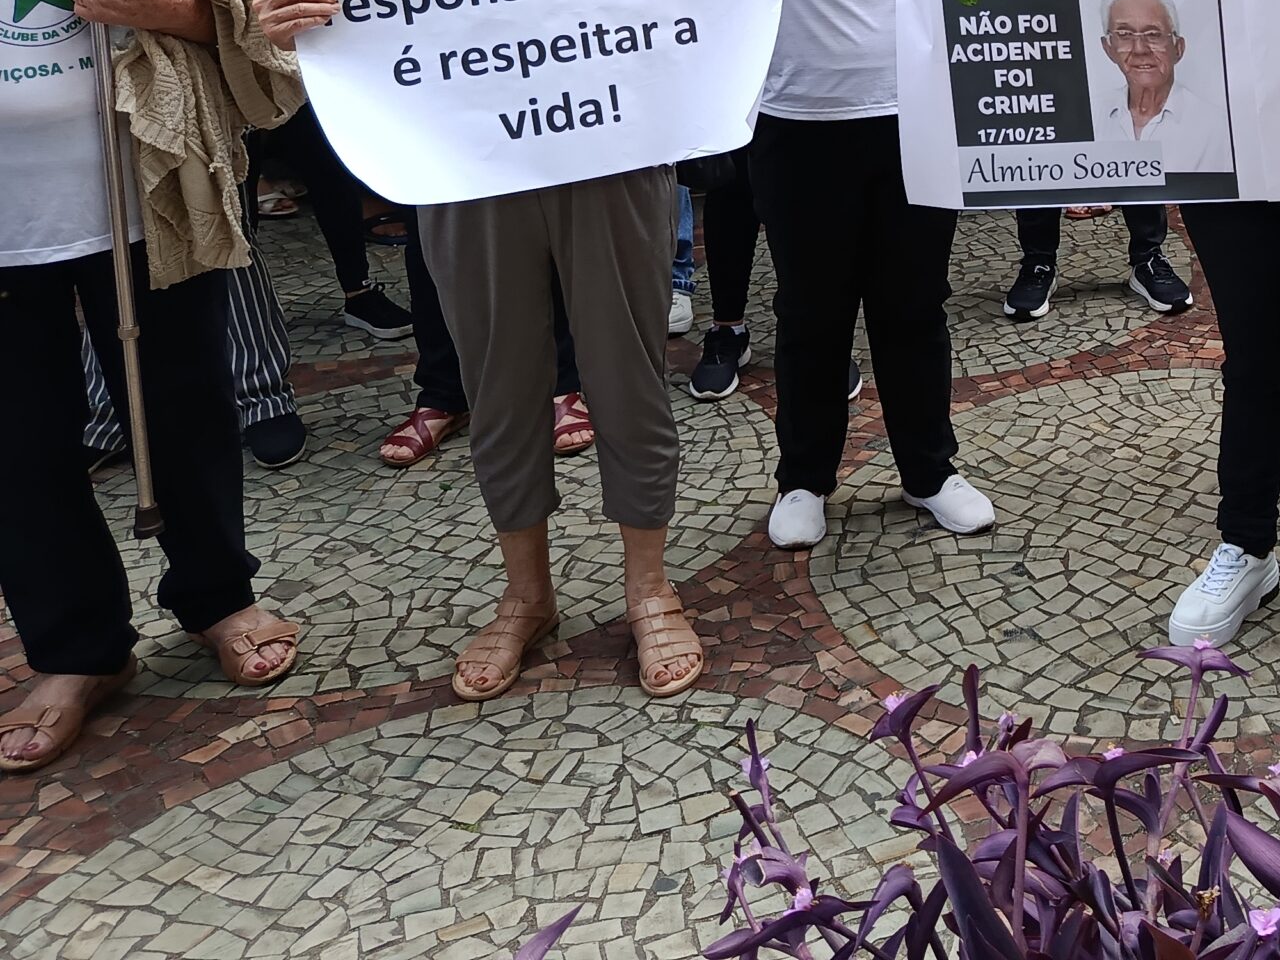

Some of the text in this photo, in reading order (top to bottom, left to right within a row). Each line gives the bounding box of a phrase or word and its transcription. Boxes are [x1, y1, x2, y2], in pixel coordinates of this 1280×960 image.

[42, 30, 60, 41] DA
[959, 10, 1057, 36] NÃO FOI
[393, 15, 699, 87] é respeitar a
[950, 40, 1072, 64] ACIDENTE
[0, 62, 63, 84] IÇOSA
[78, 56, 94, 70] M
[994, 68, 1034, 88] FOI
[498, 84, 622, 140] vida!
[977, 94, 1056, 115] CRIME
[977, 127, 1056, 144] 17/10/25
[967, 153, 1162, 184] Almiro Soares
